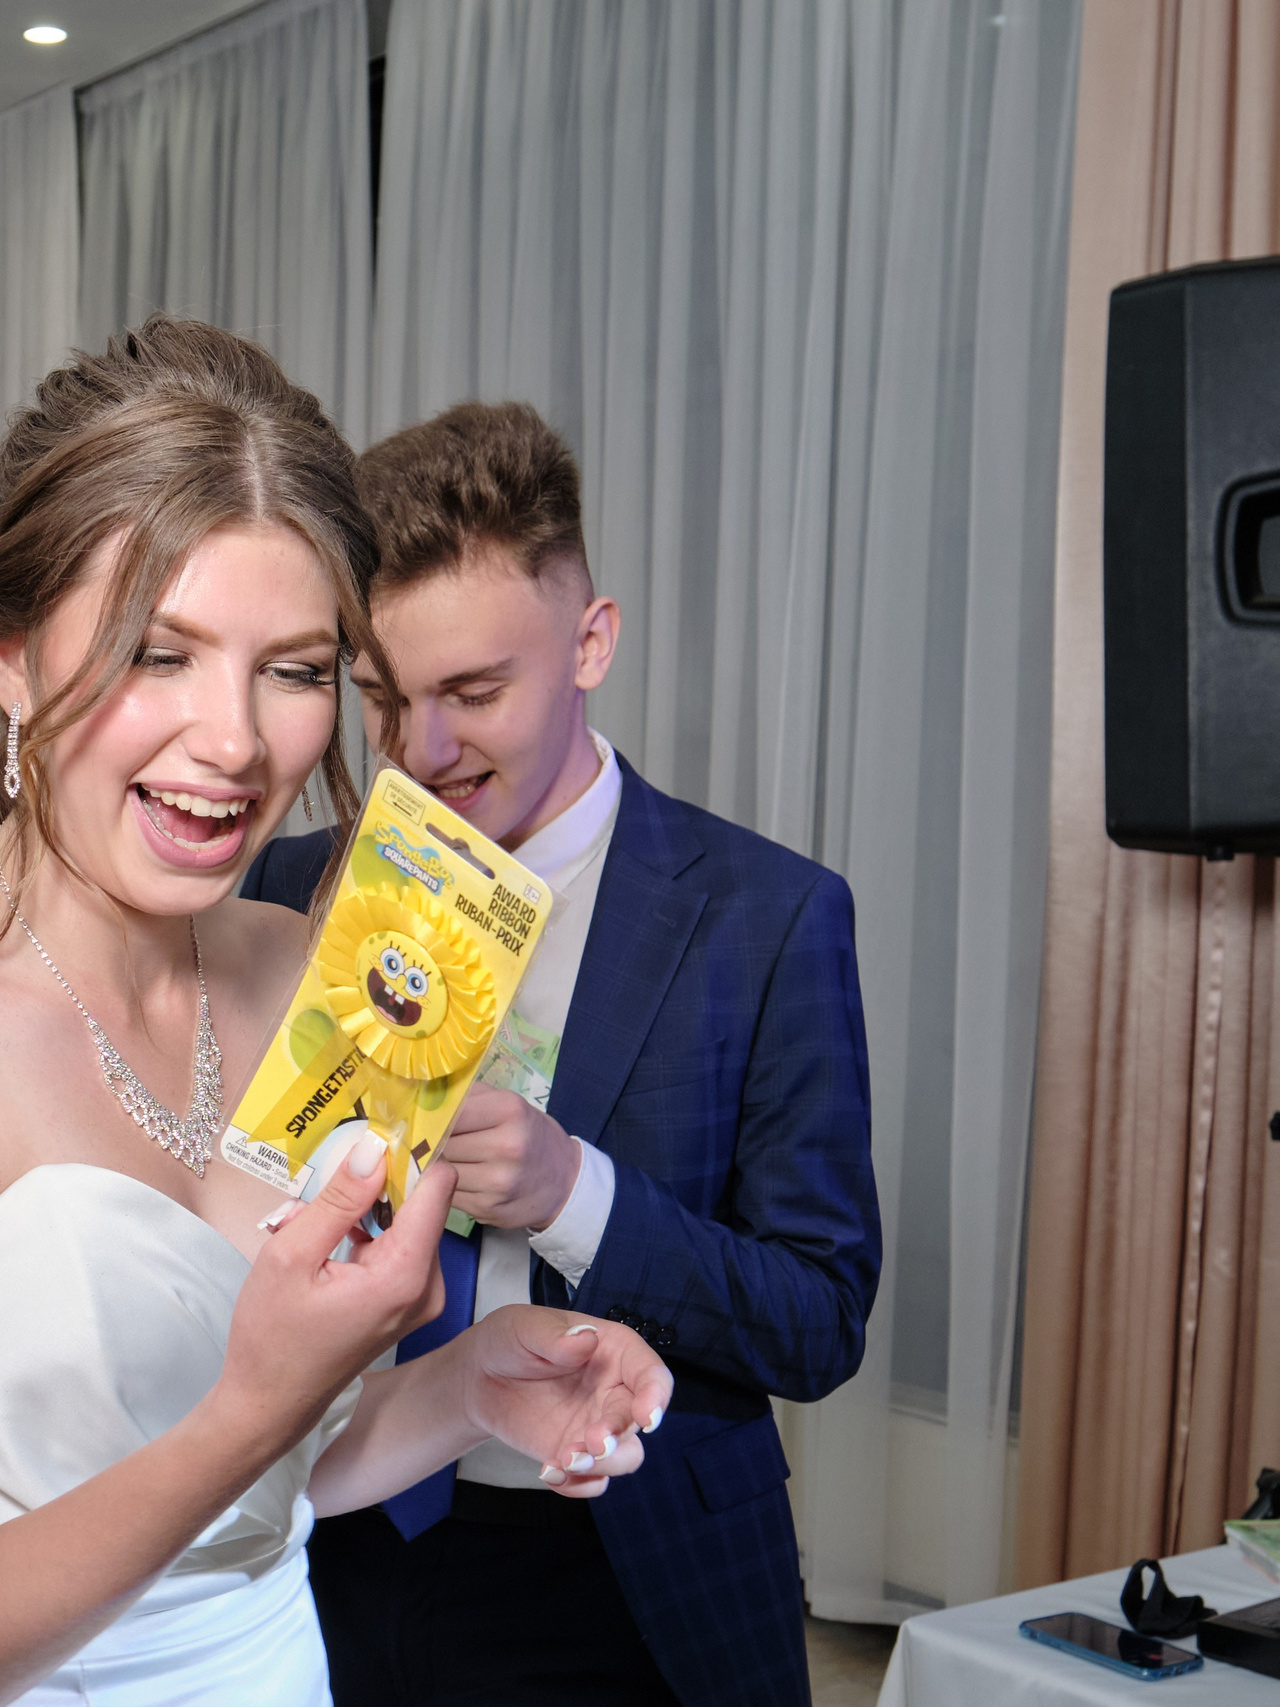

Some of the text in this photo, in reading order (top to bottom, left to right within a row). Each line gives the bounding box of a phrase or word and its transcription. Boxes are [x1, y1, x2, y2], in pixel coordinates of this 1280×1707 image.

[384, 847, 439, 890] SQUAREPANTS
[488, 897, 531, 939] RIBBON
[493, 883, 536, 924] AWARD
[455, 893, 524, 957] RUBAN-PRIX
[226, 1142, 251, 1159] CHOKING
[250, 1155, 272, 1171] HAZARD
[242, 1162, 261, 1175] children
[260, 1170, 273, 1182] under
